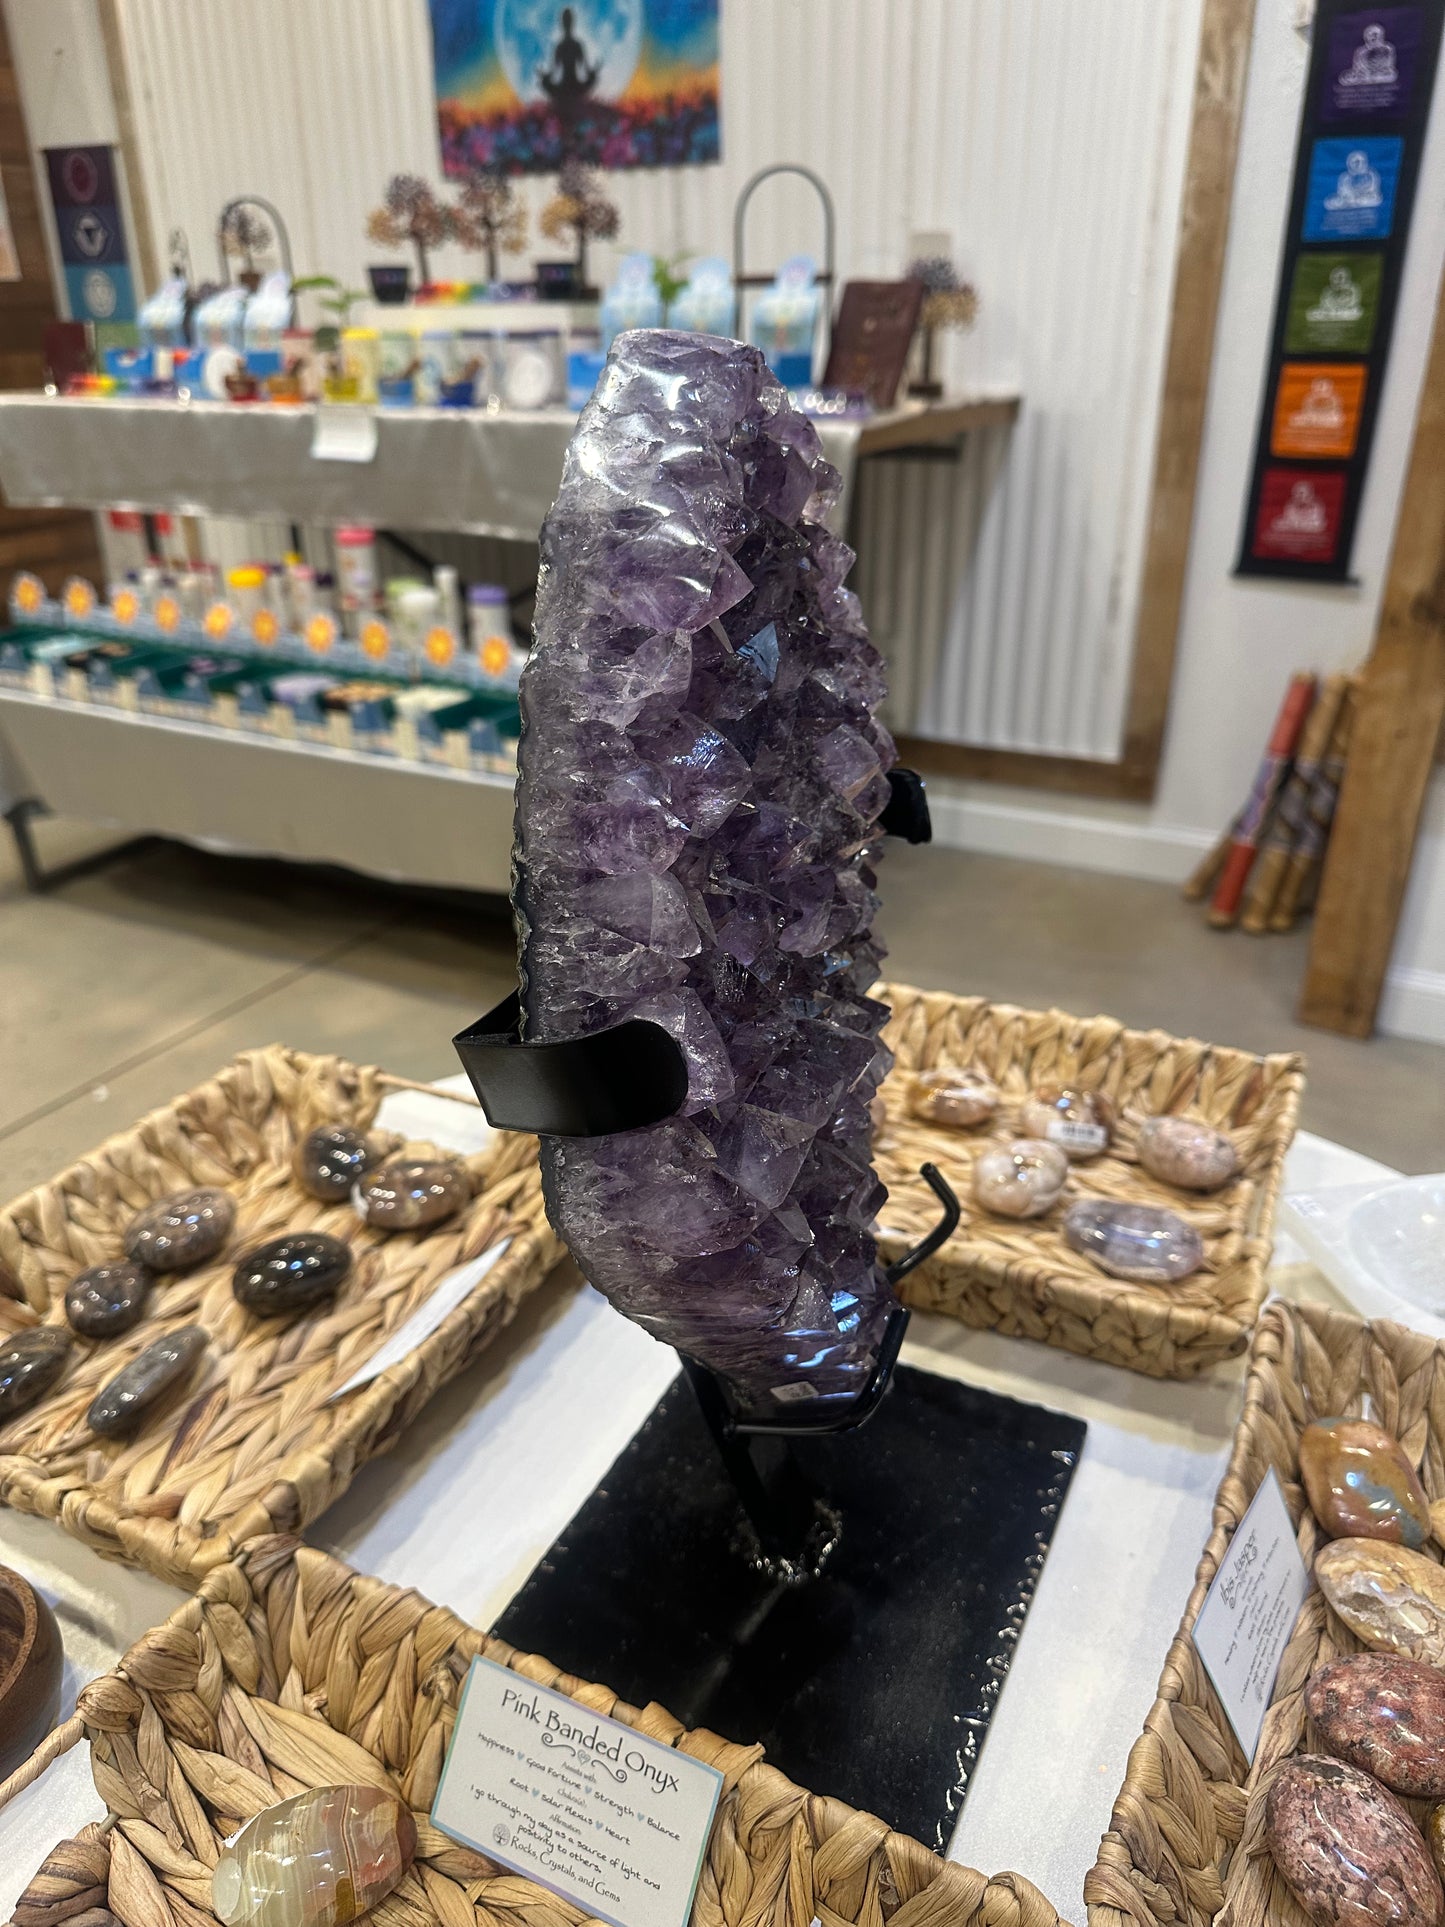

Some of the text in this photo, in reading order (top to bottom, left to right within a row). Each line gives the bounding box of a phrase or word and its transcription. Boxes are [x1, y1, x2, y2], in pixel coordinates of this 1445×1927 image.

[502, 1689, 679, 1794] Pink Banded Onyx
[477, 1732, 515, 1756] Happiness
[546, 1766, 582, 1790] Fortune
[593, 1791, 635, 1818] Strength
[646, 1816, 681, 1841] Balance
[509, 1777, 529, 1793] Root
[540, 1793, 564, 1809] Solar
[604, 1826, 631, 1846] Heart
[474, 1788, 485, 1800] go
[487, 1792, 522, 1820] through
[523, 1813, 537, 1830] my
[537, 1821, 553, 1839] day
[554, 1830, 567, 1840] as
[567, 1837, 575, 1845] a
[577, 1840, 607, 1862] source
[609, 1857, 621, 1869] of
[620, 1861, 641, 1881] light
[643, 1878, 661, 1891] and
[510, 1835, 621, 1903] Rocks, Crystals, and Gems
[557, 1843, 568, 1855] to
[568, 1851, 602, 1874] others.
